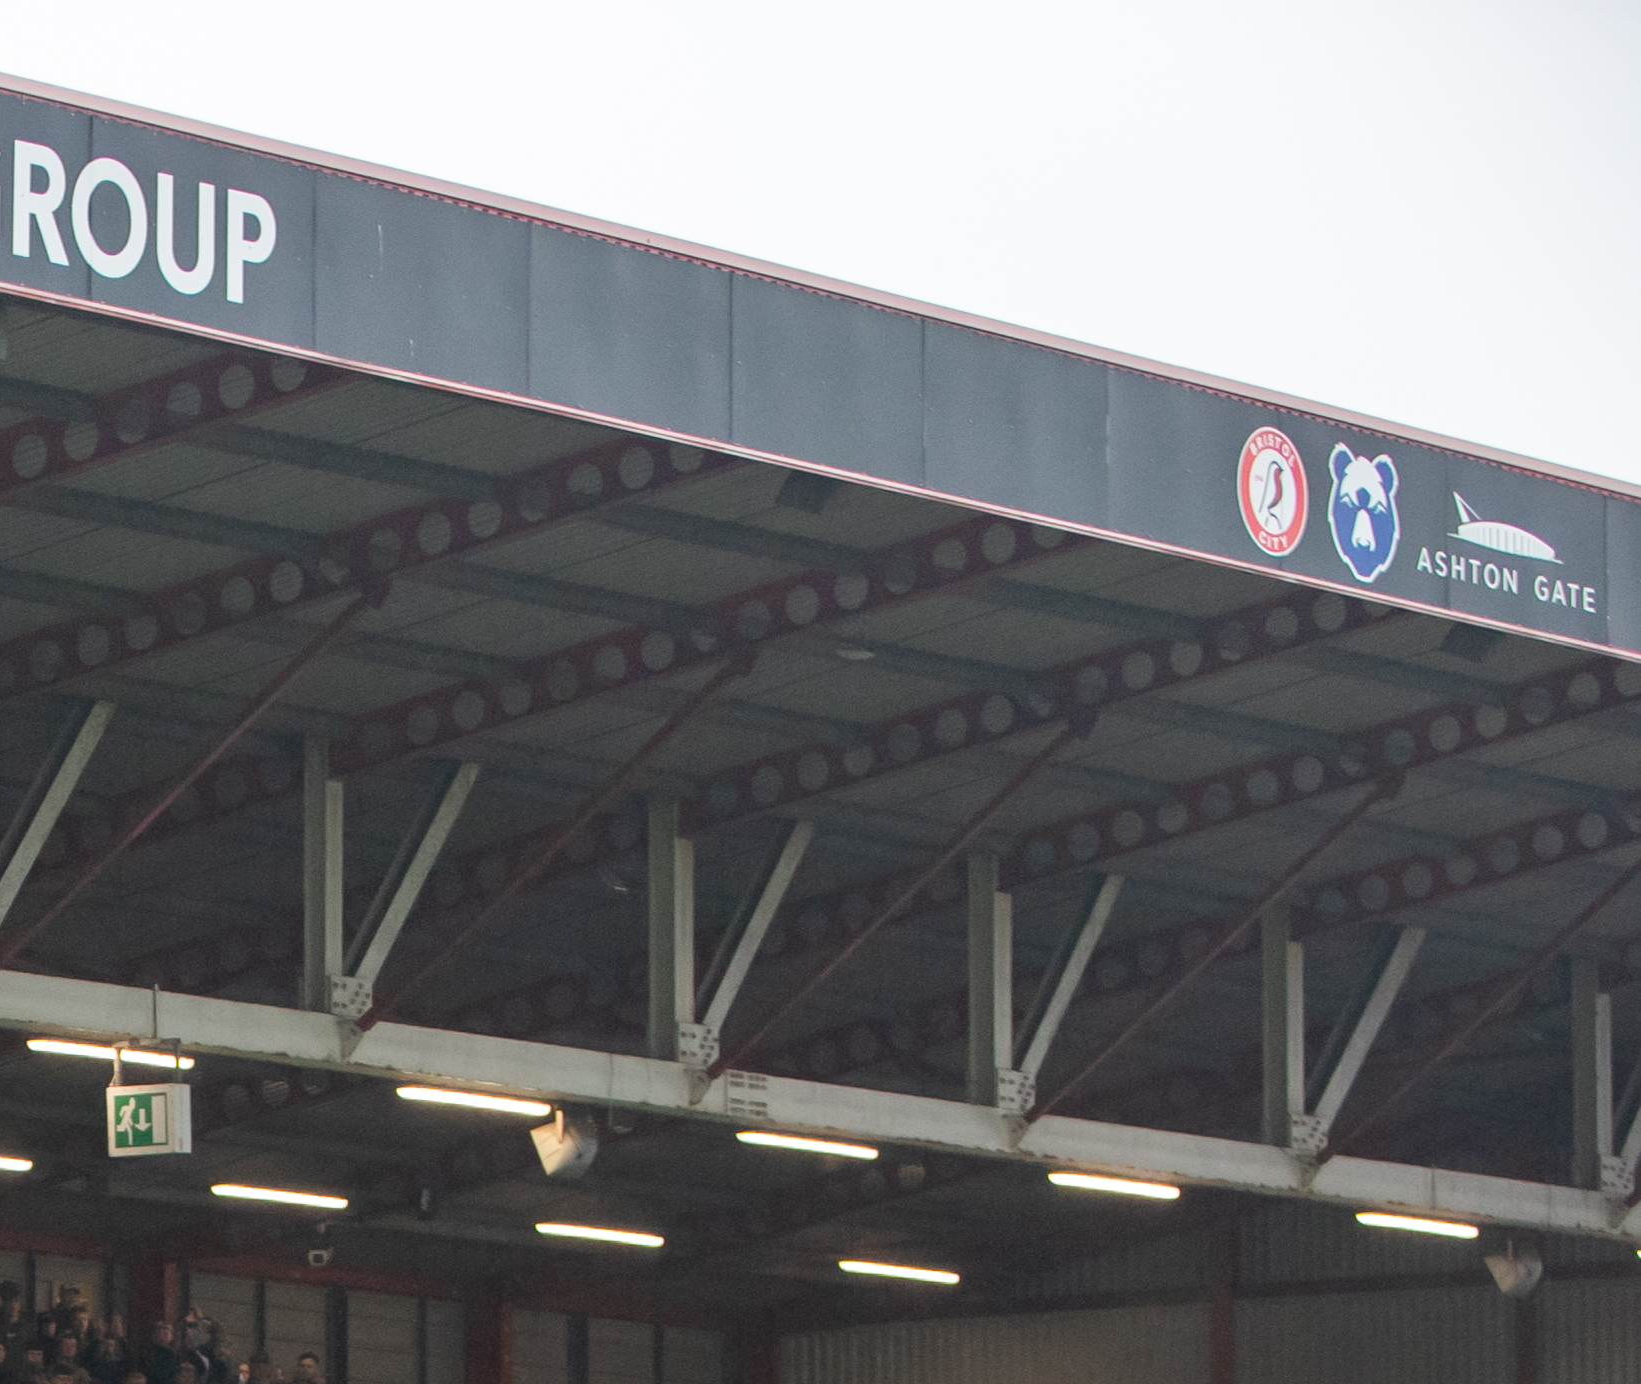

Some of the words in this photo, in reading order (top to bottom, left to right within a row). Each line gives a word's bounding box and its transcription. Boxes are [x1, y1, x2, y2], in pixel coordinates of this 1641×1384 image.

[1249, 434, 1296, 467] BRISTOL
[1258, 530, 1288, 551] CITY
[1417, 546, 1518, 595] ASHTON
[1534, 574, 1597, 614] GATE
